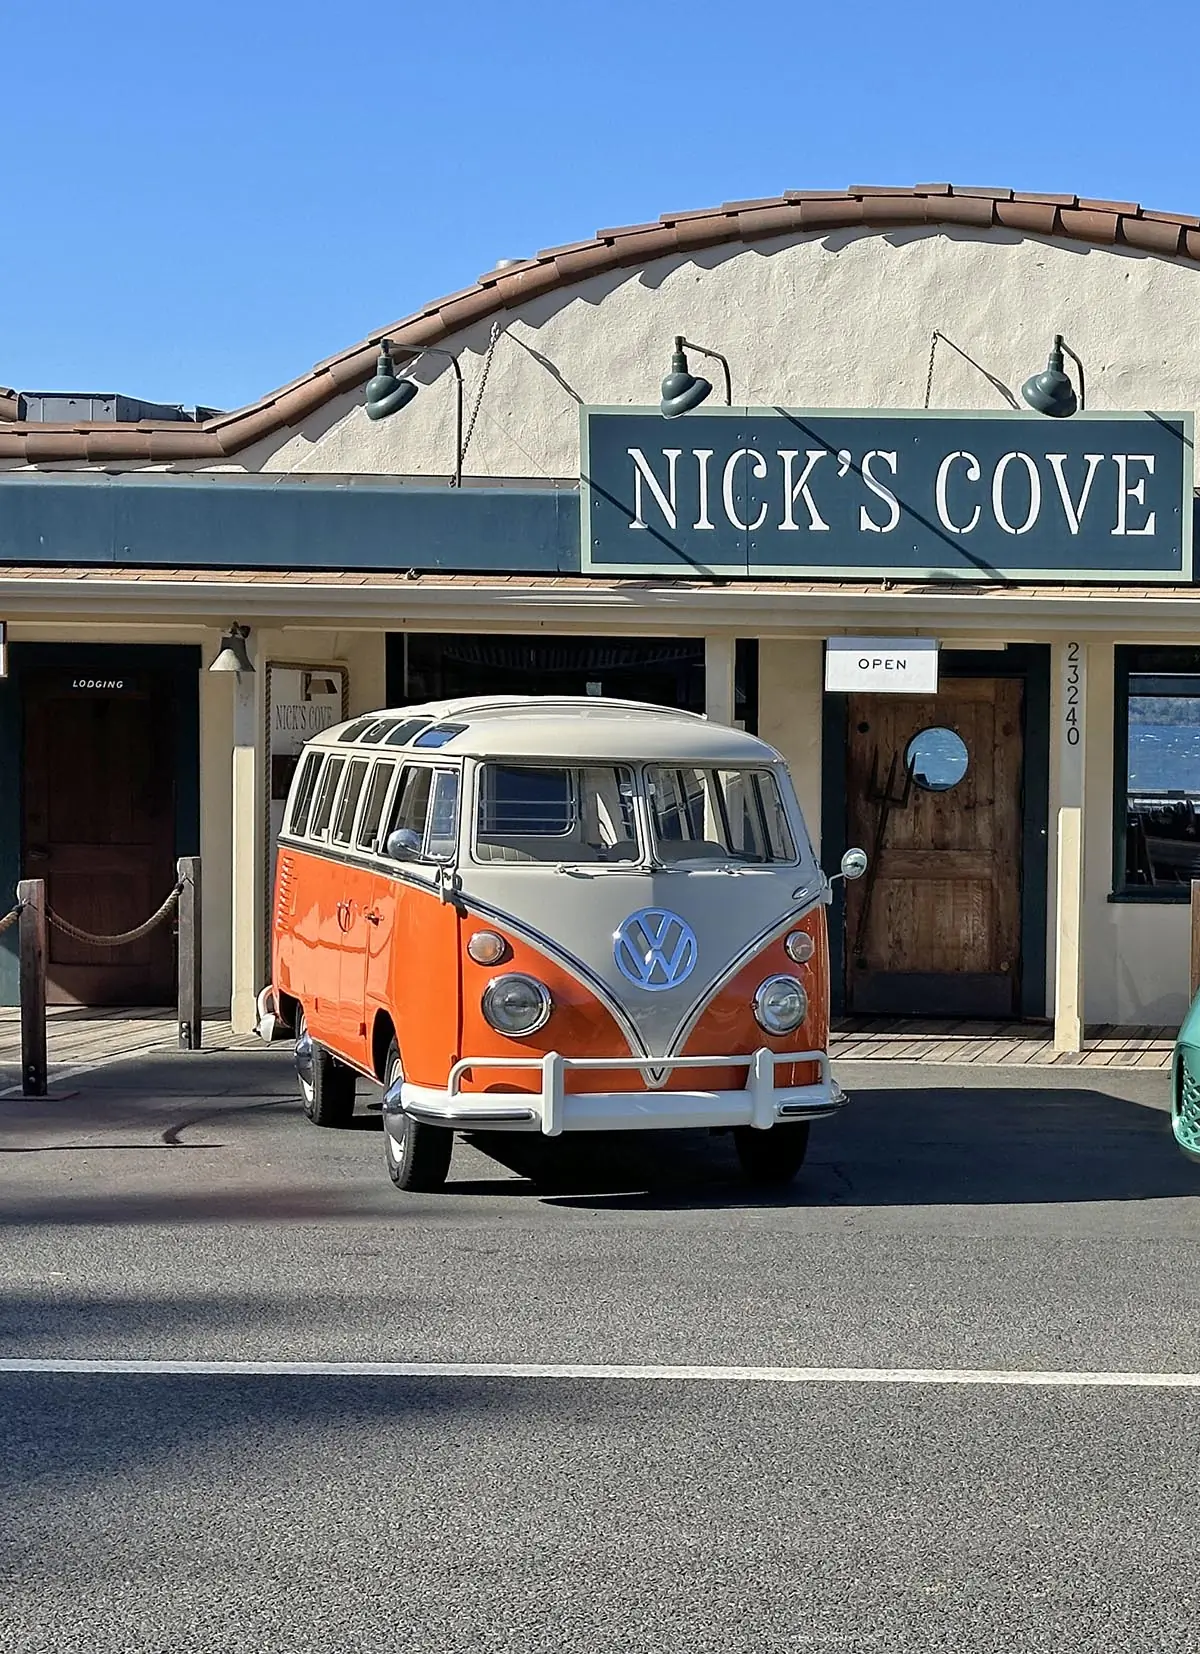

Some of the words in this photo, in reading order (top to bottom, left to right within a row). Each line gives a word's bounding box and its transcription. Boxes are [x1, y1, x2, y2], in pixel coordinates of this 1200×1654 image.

[626, 447, 900, 534] NICK'S
[935, 450, 1157, 536] COVE
[72, 679, 124, 689] LODGING
[858, 658, 907, 670] OPEN
[275, 704, 306, 730] NICK'S
[1065, 641, 1080, 746] 23240
[615, 908, 696, 990] VW
